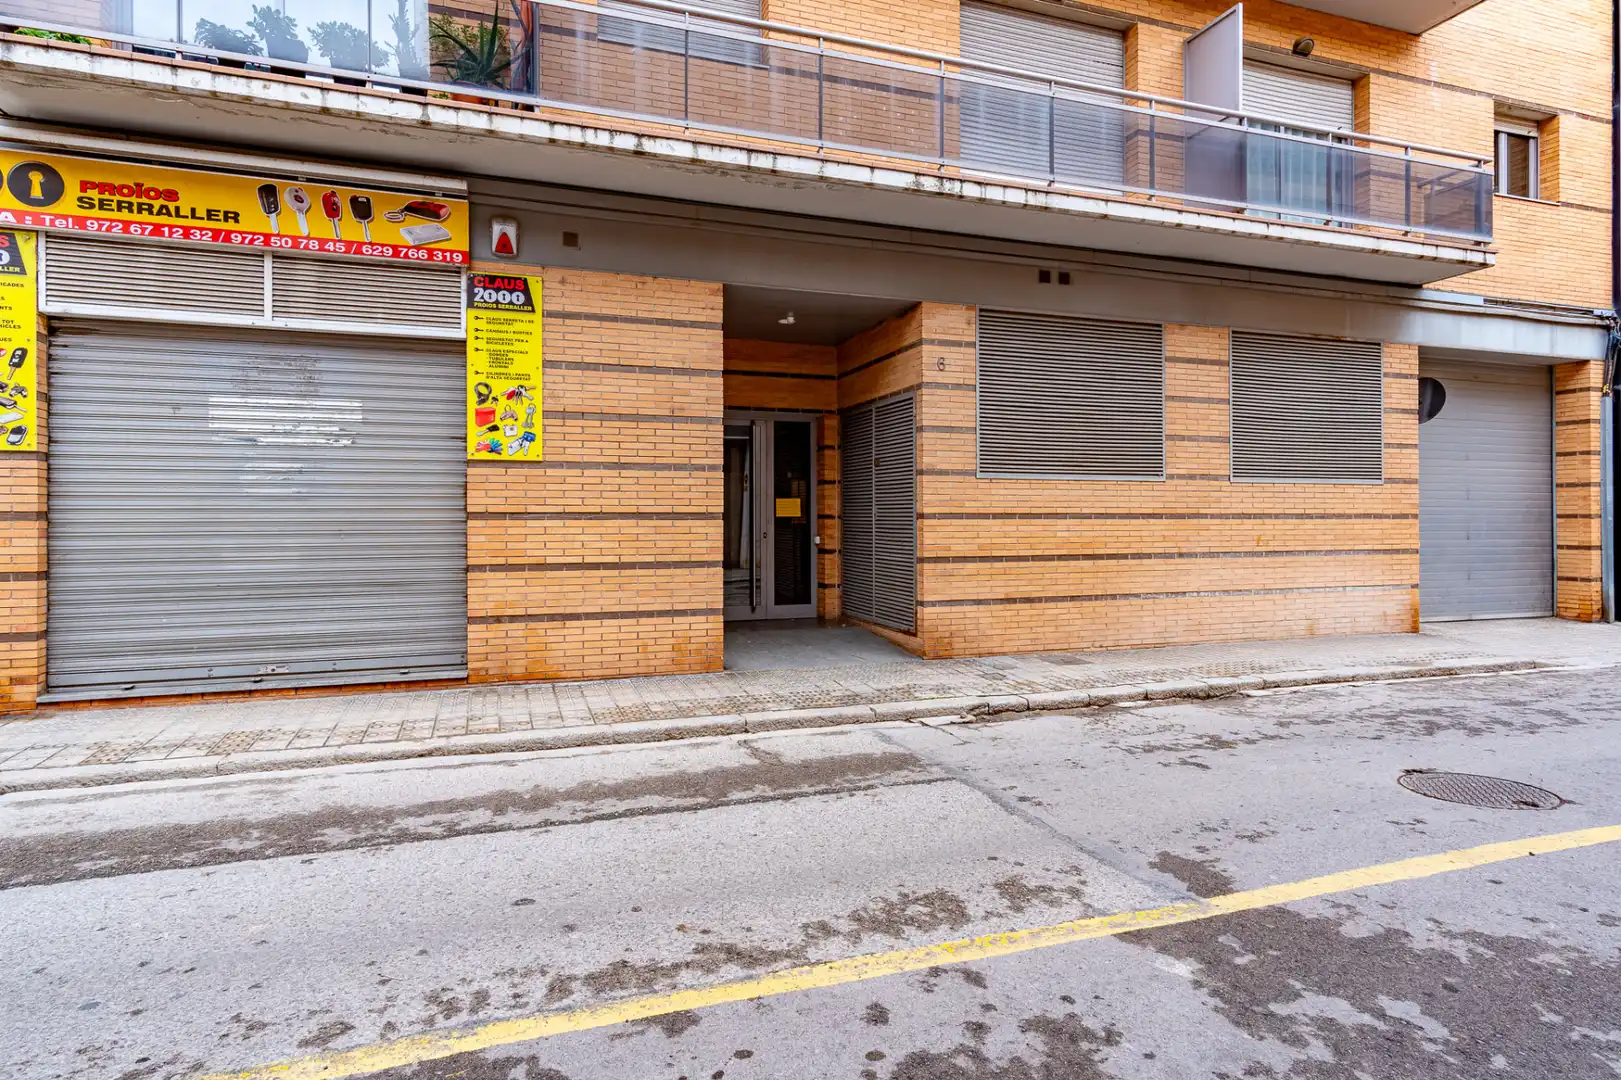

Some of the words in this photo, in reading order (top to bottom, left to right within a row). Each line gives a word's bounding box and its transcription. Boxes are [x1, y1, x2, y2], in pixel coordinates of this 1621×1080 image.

[79, 180, 180, 202] PROÏOS
[77, 196, 240, 224] SERRALLER
[41, 215, 79, 229] Tel.
[86, 220, 123, 233] 972
[129, 223, 154, 236] 67
[161, 226, 184, 239] 12
[189, 229, 213, 241] 32
[230, 232, 264, 246] 972
[270, 236, 292, 248] 50
[297, 239, 319, 251] 78
[324, 241, 346, 252] 45
[362, 244, 393, 257] 629
[398, 247, 428, 260] 766
[433, 250, 463, 263] 319
[473, 276, 525, 291] CLAUS
[473, 287, 525, 305] 2000
[937, 357, 945, 371] 6
